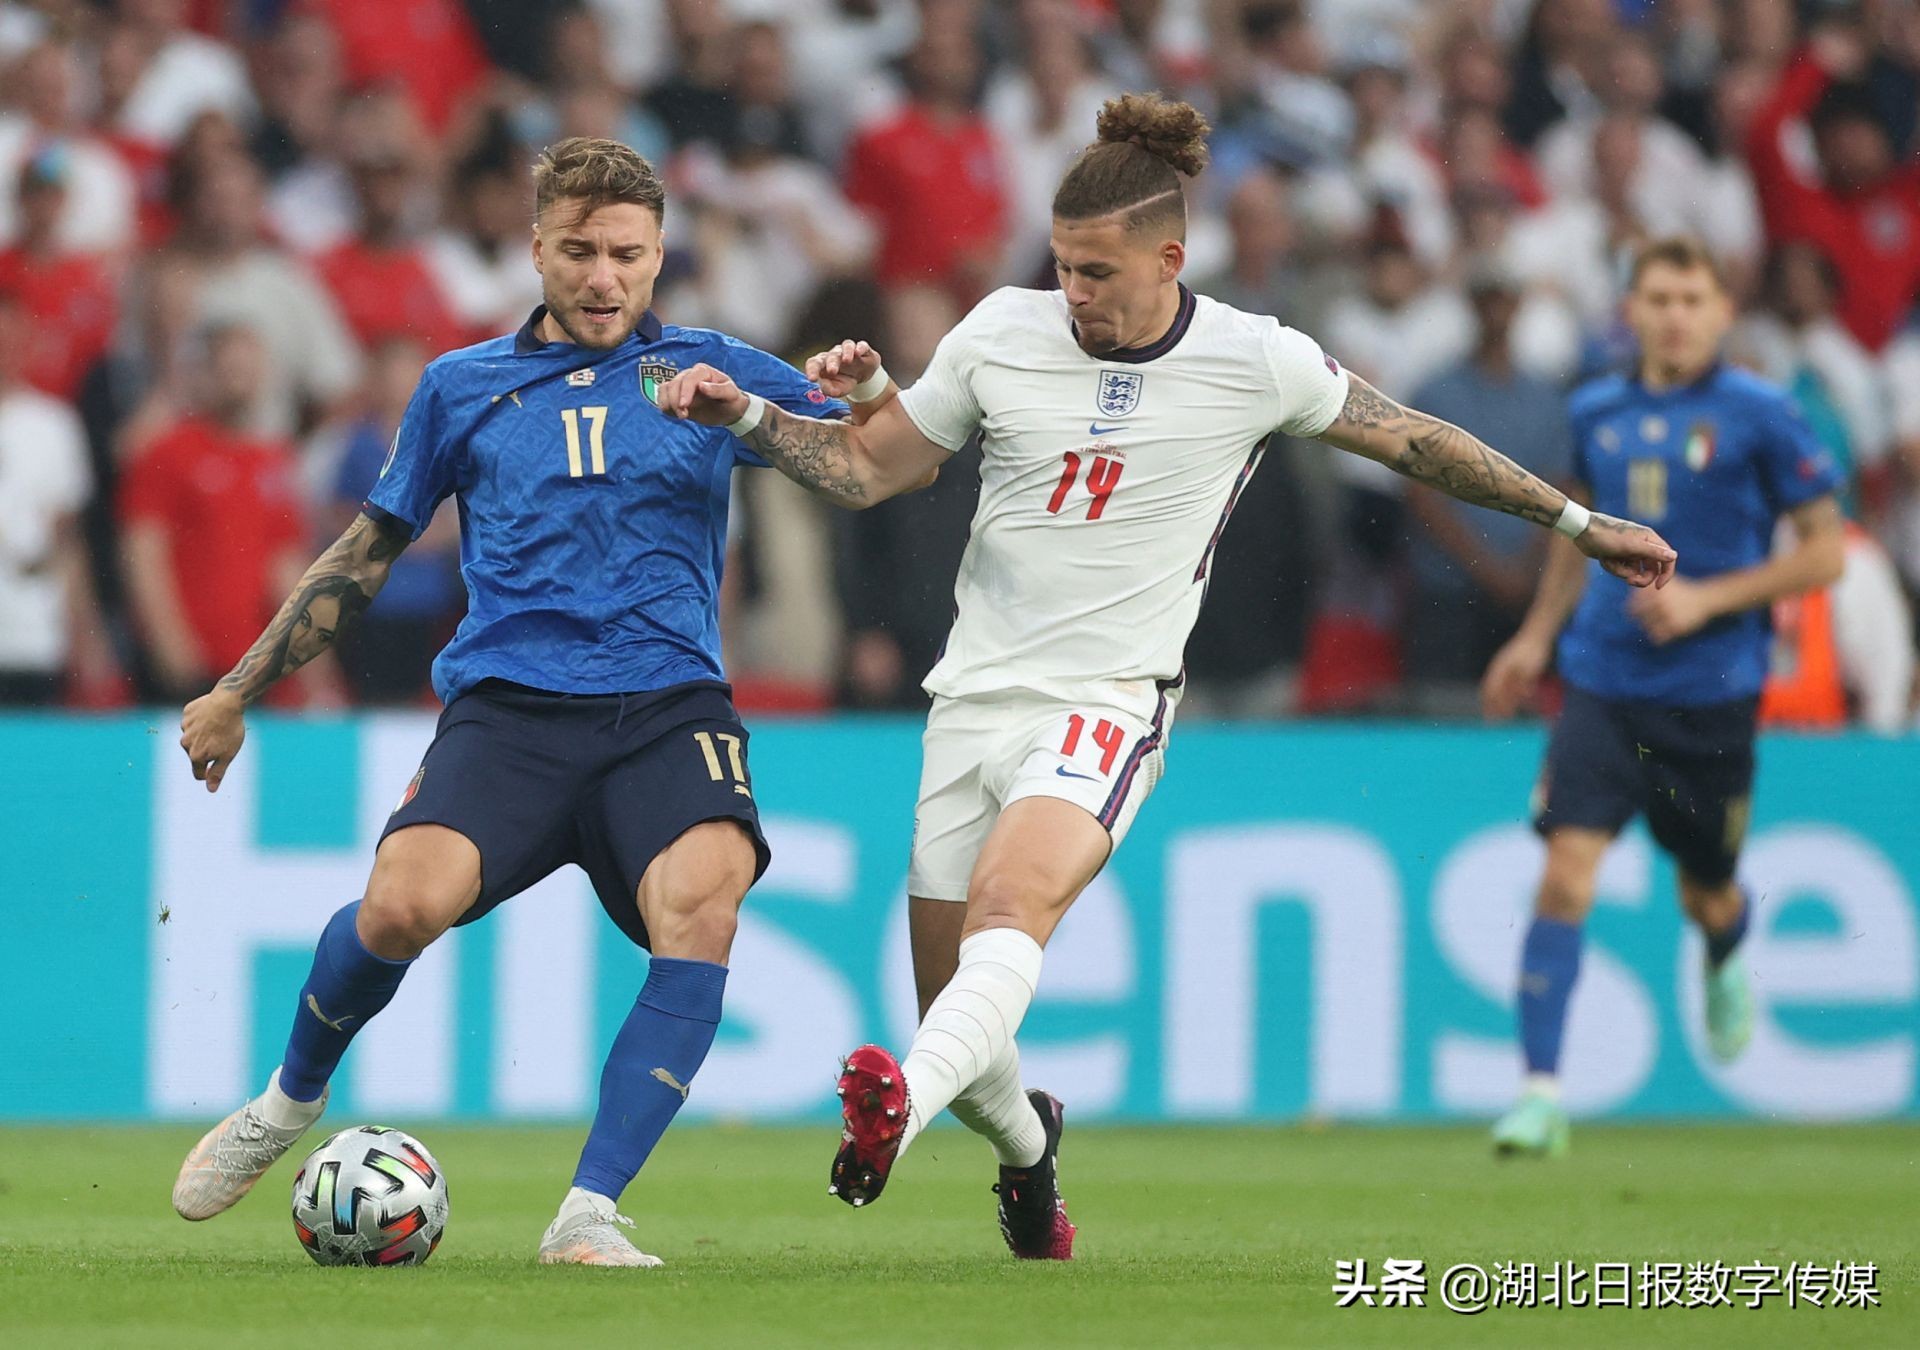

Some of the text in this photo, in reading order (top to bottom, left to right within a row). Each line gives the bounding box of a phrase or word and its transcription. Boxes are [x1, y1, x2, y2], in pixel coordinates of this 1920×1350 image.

[642, 367, 675, 377] ITALIA
[560, 406, 608, 478] 17
[1046, 451, 1124, 520] 14
[693, 731, 745, 783] 17
[1060, 713, 1125, 777] 14
